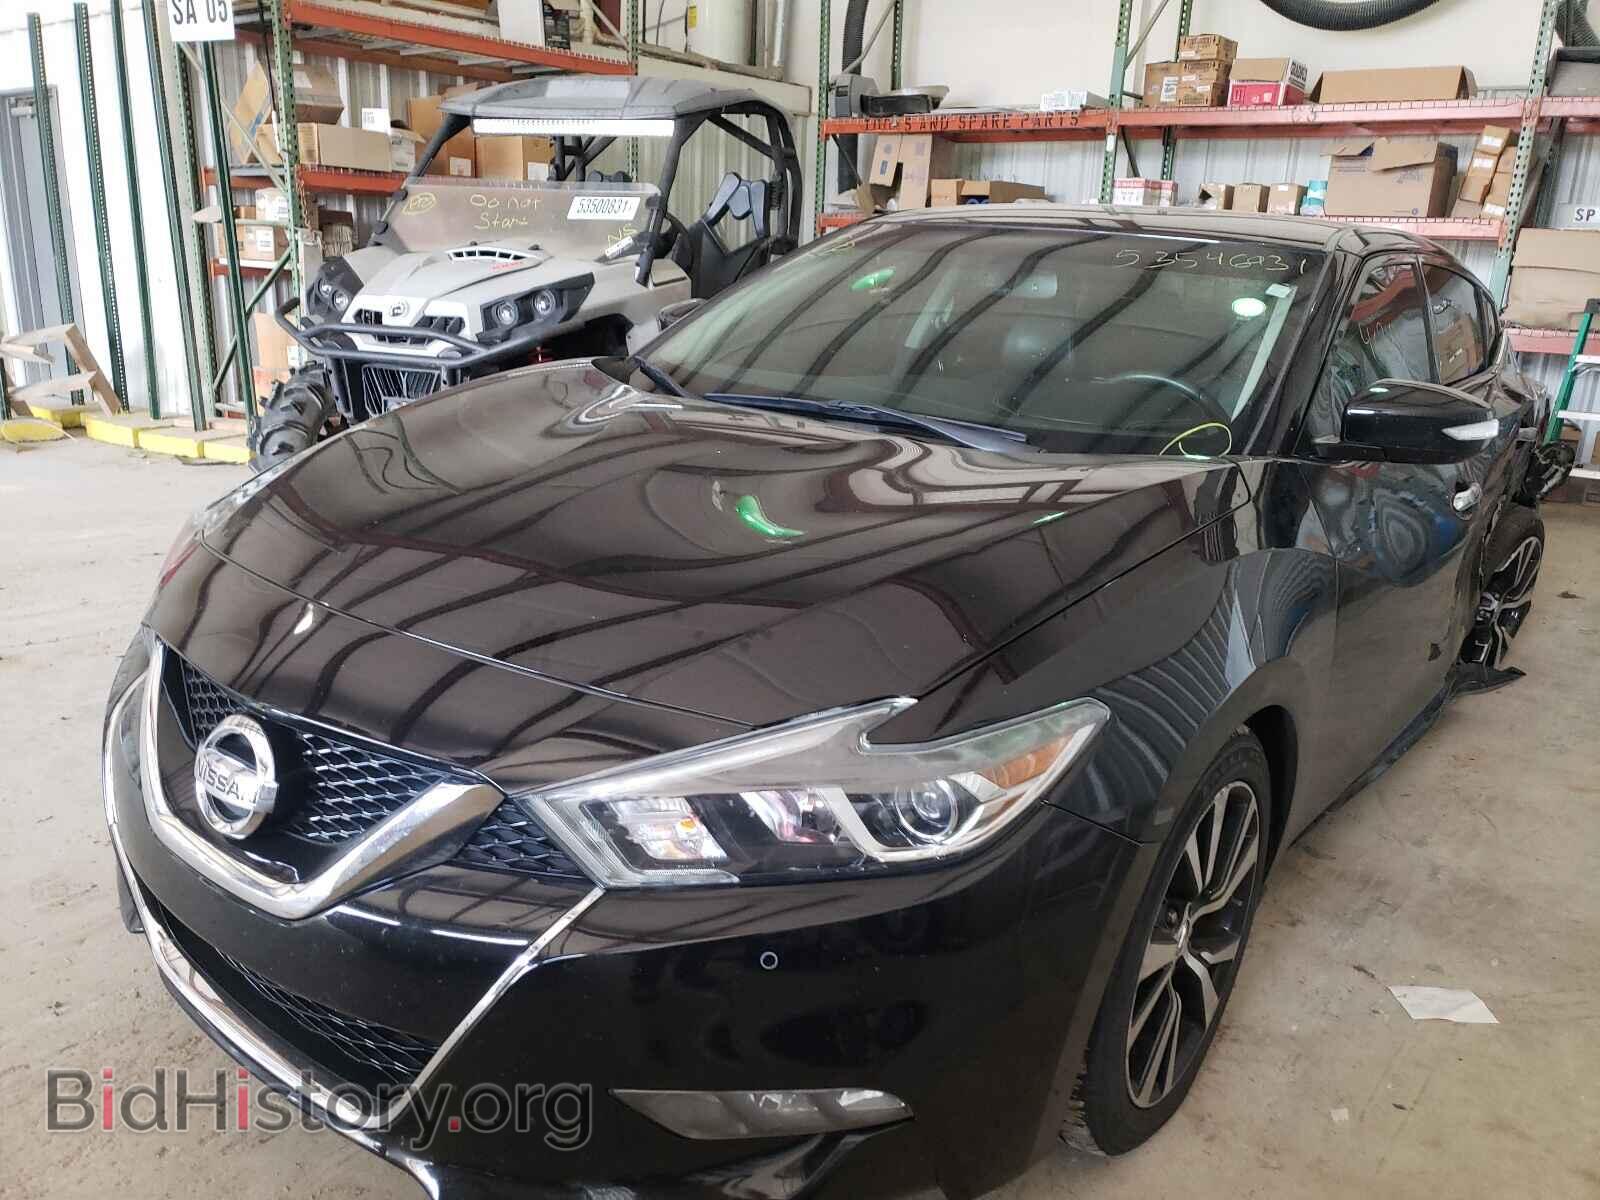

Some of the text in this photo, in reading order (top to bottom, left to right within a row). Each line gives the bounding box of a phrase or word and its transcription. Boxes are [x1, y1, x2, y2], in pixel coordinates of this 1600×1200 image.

[172, 0, 228, 24] SA 05
[919, 115, 949, 130] AND
[958, 112, 1013, 130] SPARE
[1020, 110, 1079, 129] PARTS
[1575, 207, 1596, 222] SP
[198, 753, 258, 805] NISSA
